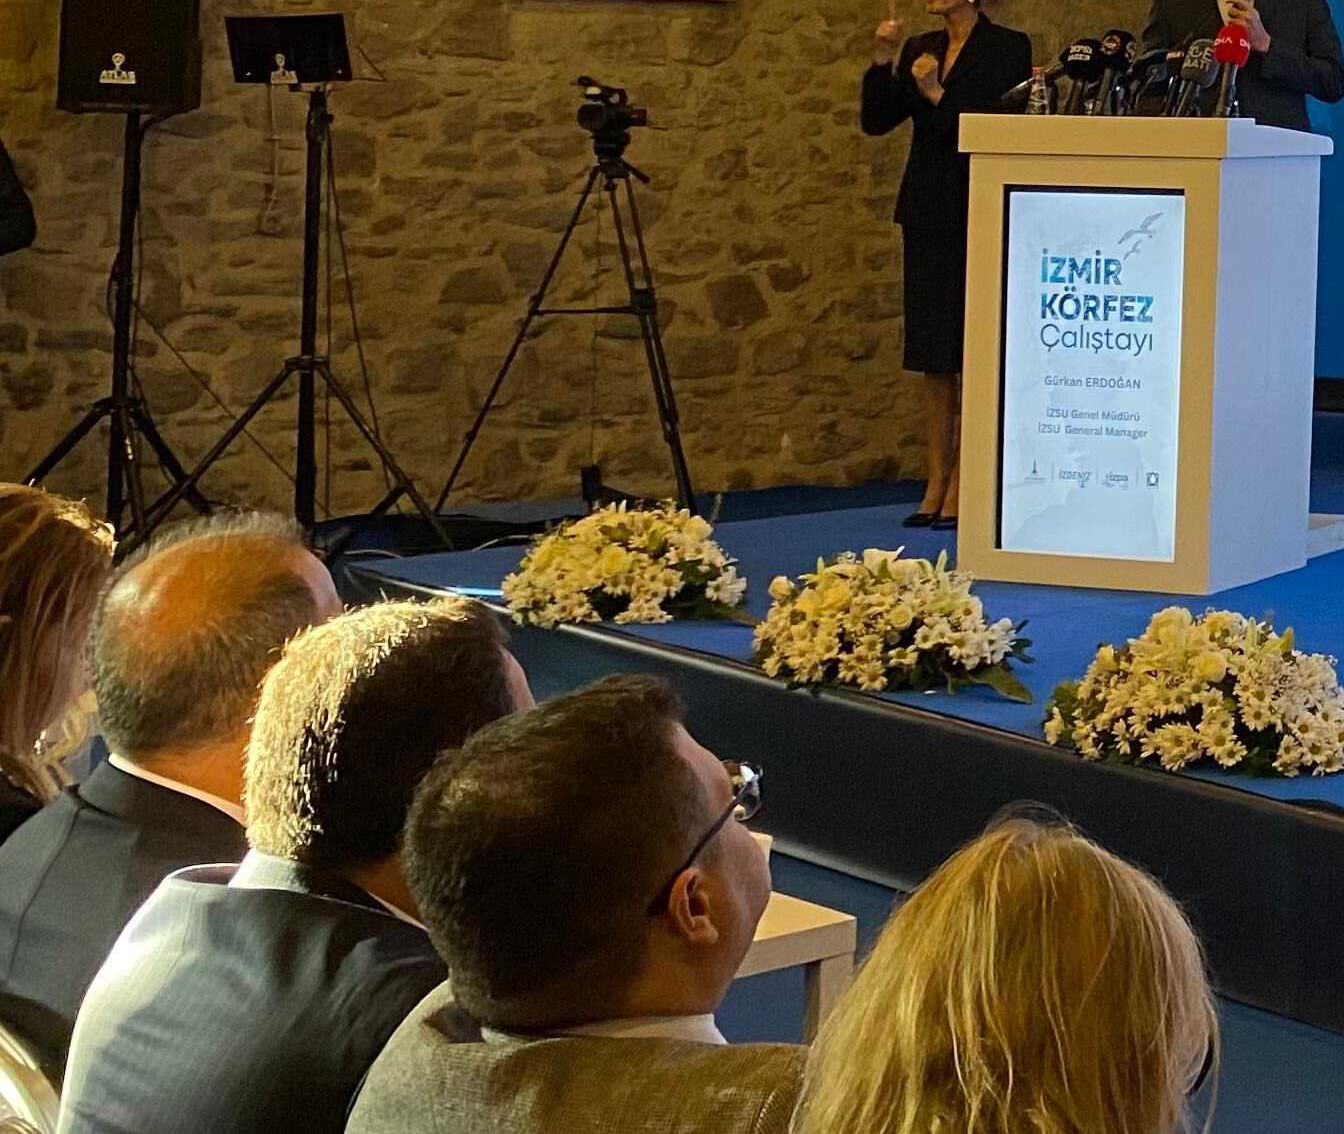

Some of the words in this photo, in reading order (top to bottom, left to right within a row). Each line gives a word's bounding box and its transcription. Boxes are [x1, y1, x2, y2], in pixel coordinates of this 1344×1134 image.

[1041, 247, 1123, 286] İZMİR
[1040, 285, 1154, 323] KÖRFEZ
[1040, 323, 1154, 356] Çalıştayı
[1044, 375, 1083, 387] Gürkan
[1085, 376, 1142, 390] ERDOĞAN
[1071, 409, 1100, 420] Genel
[1101, 411, 1141, 422] Müdürü
[1064, 425, 1103, 436] General
[1105, 427, 1148, 440] Manager
